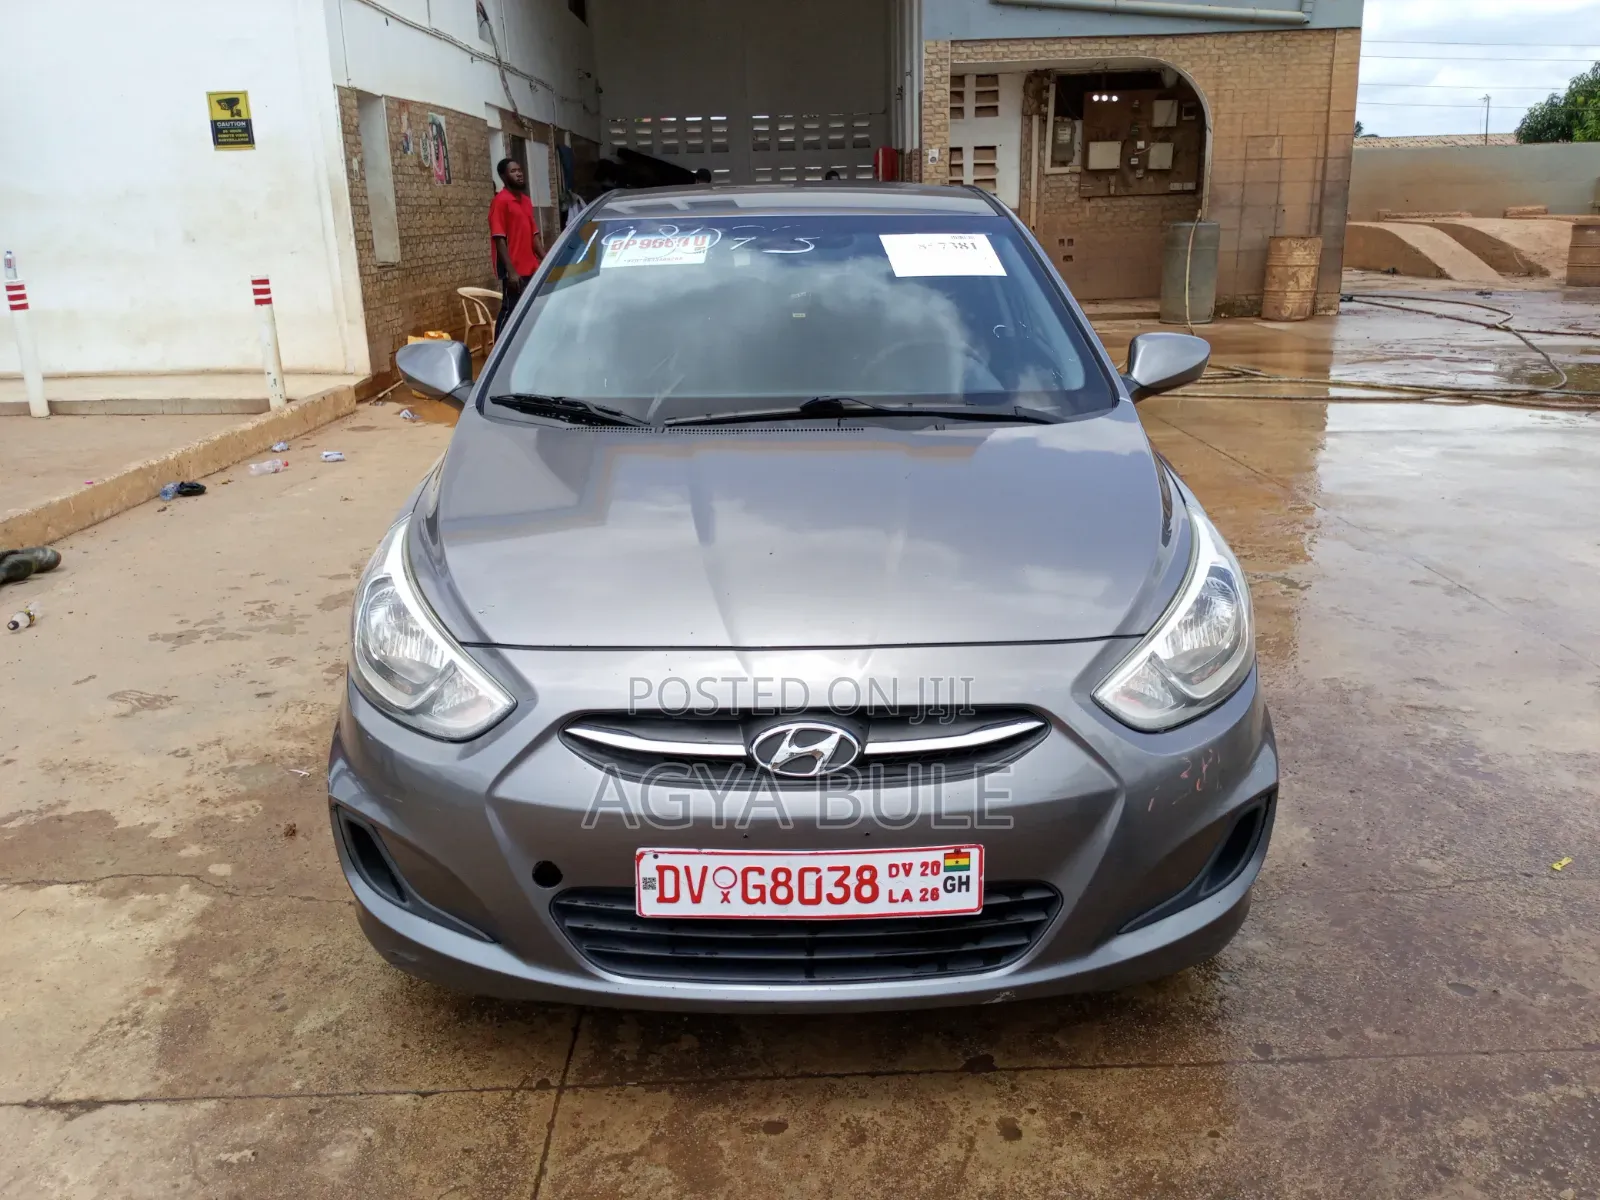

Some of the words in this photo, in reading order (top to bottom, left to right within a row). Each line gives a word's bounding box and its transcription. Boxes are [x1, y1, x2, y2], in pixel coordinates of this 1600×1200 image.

[888, 862, 914, 878] DV
[920, 860, 942, 876] 20
[655, 864, 709, 905] DV
[740, 864, 880, 906] G8038
[943, 875, 971, 894] GH
[888, 888, 914, 904] LA
